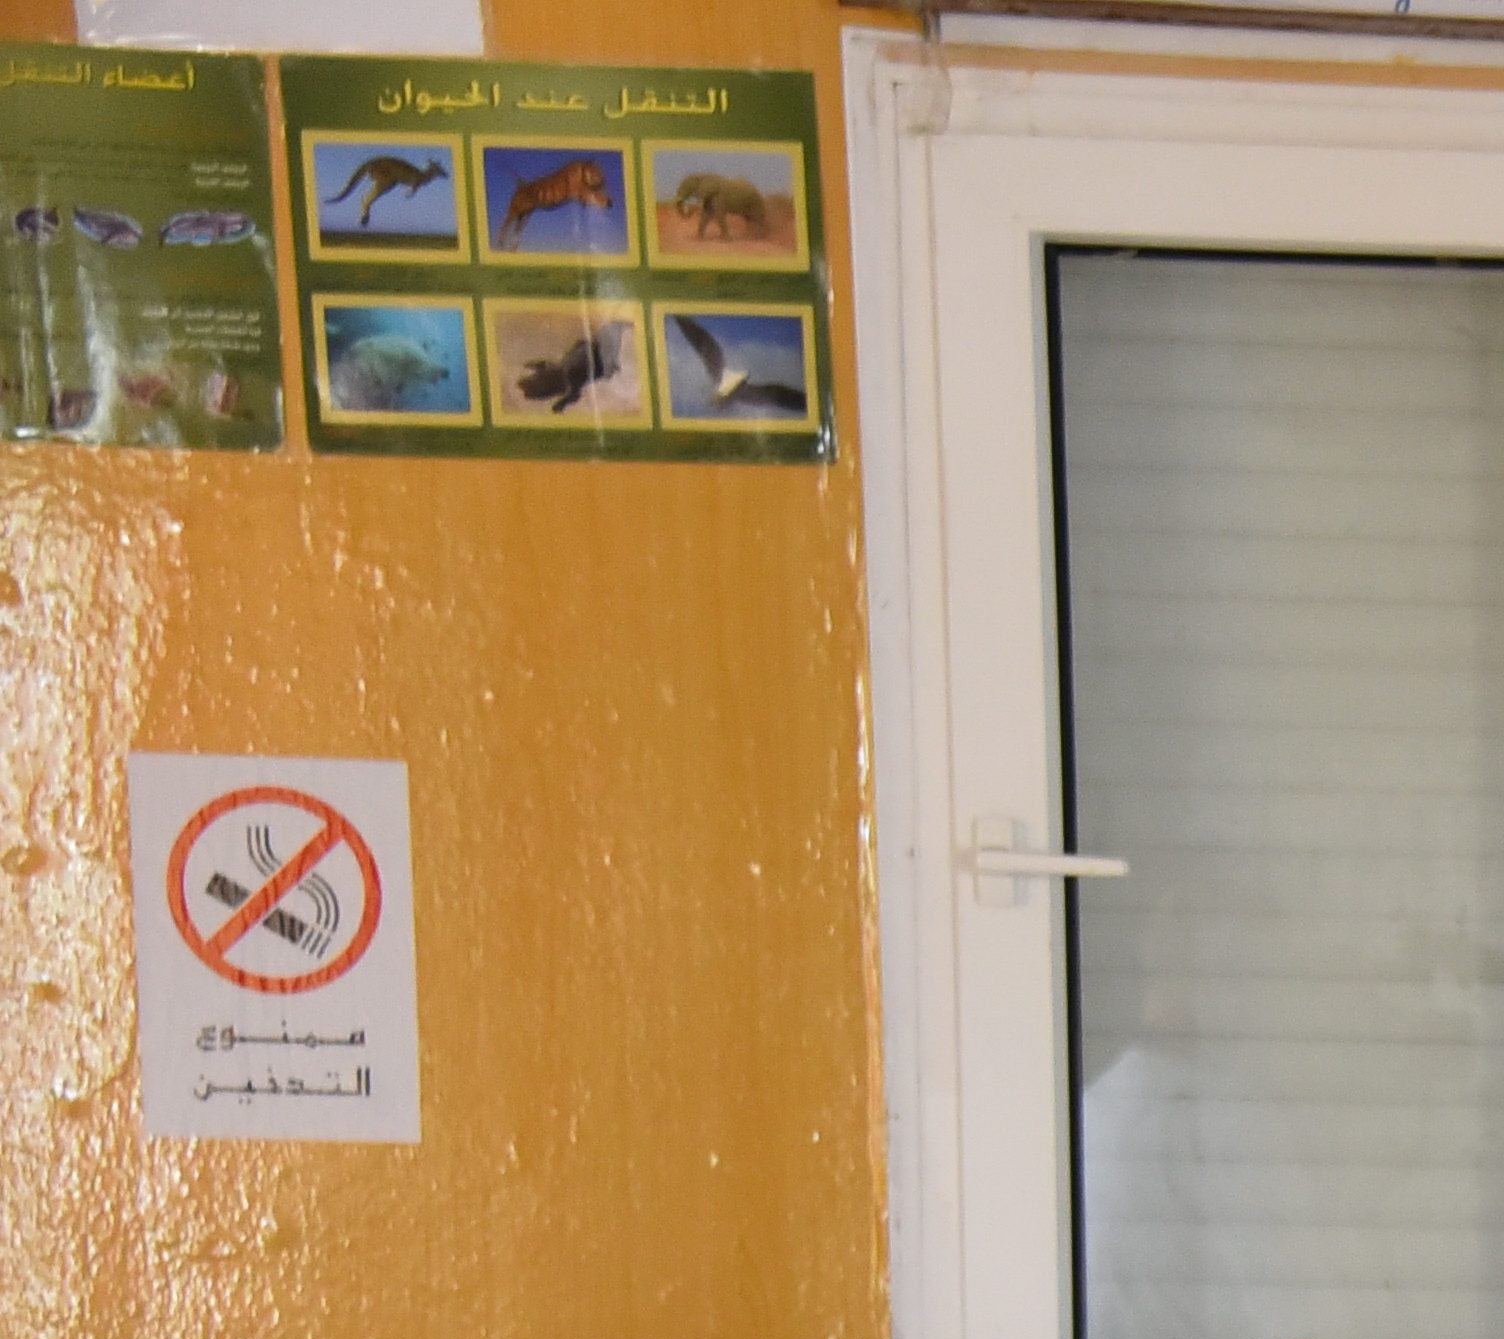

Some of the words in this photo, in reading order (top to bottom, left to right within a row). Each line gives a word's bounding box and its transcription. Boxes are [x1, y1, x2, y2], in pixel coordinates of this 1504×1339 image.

[378, 78, 500, 115] الحيوان
[516, 90, 590, 110] عند
[604, 87, 724, 119] التنقل
[194, 1066, 371, 1105] التدخين
